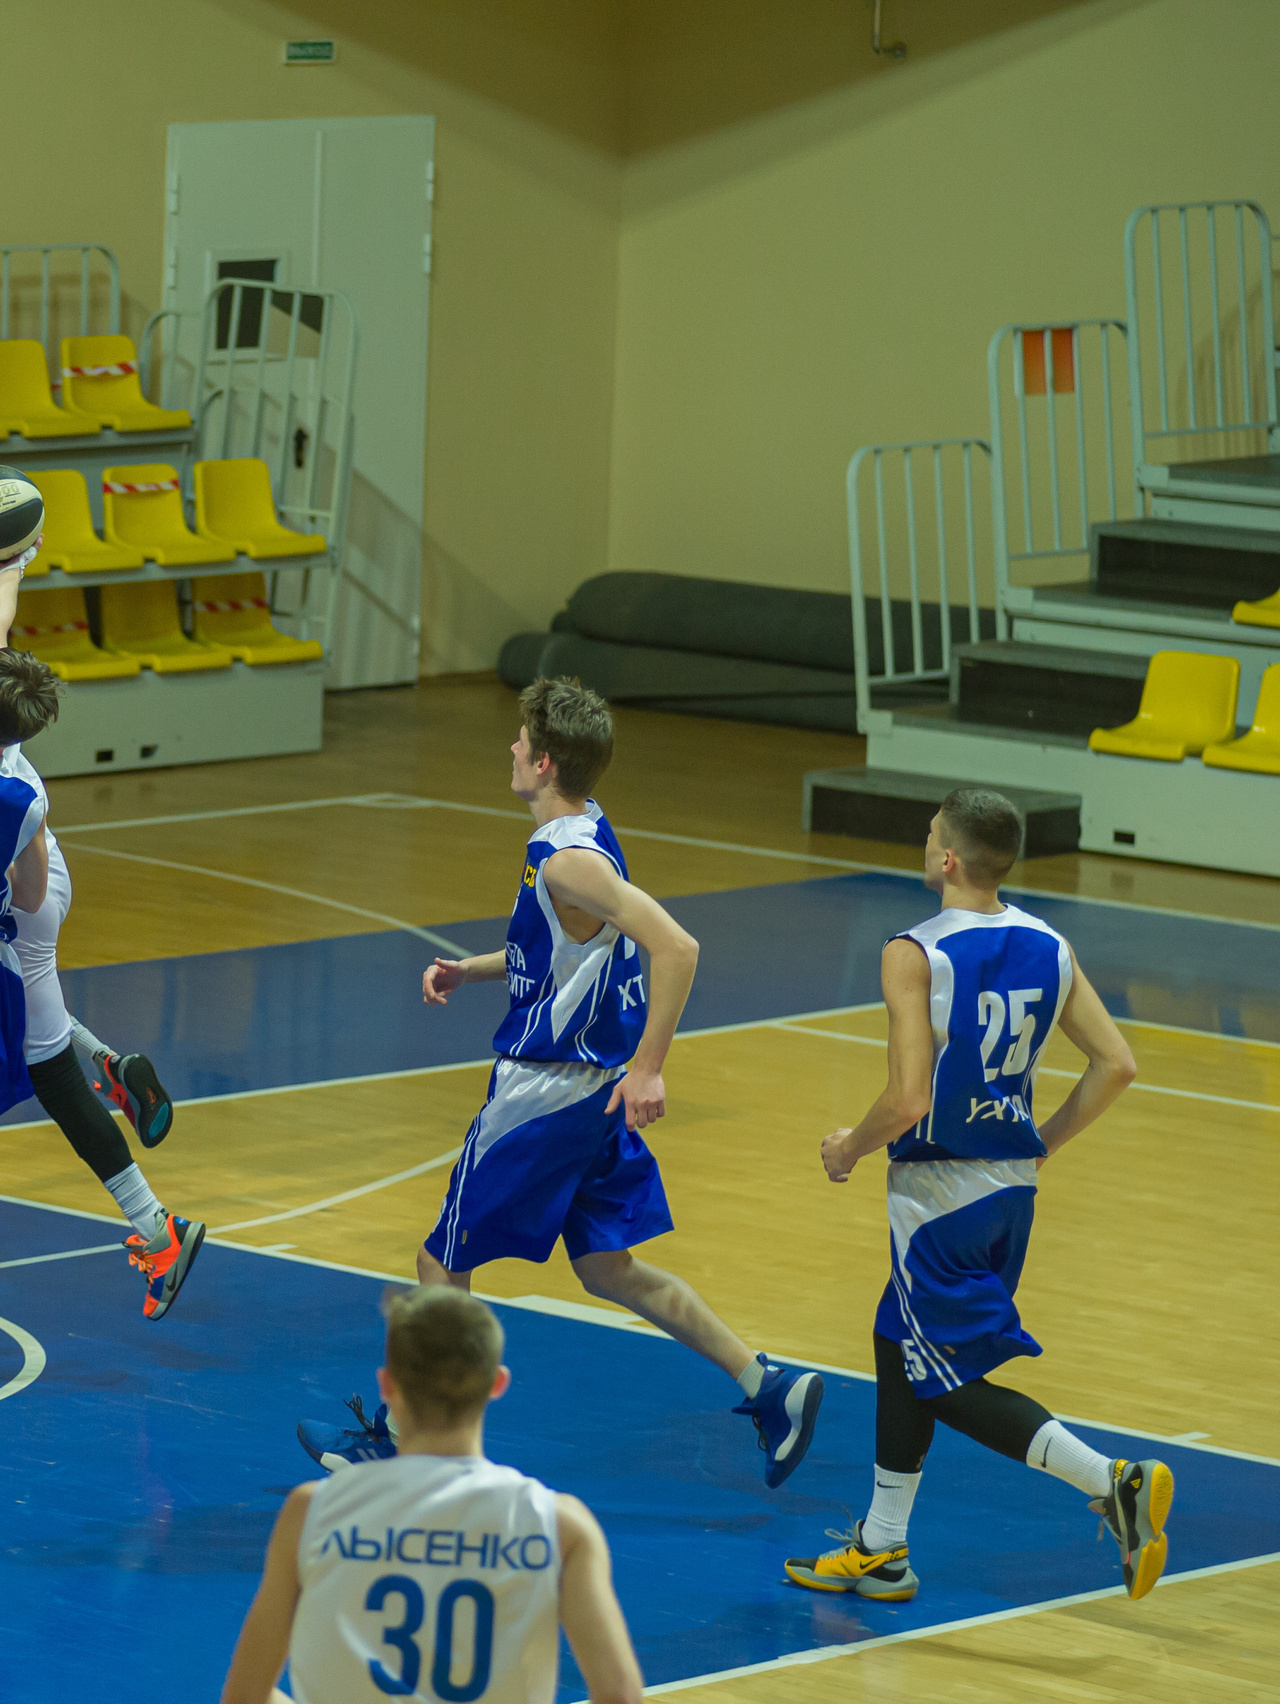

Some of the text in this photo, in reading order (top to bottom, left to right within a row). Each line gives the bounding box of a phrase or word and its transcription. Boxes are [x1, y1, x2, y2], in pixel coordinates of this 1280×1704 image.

[978, 988, 1043, 1083] 25
[901, 1339, 927, 1381] 5
[320, 1525, 552, 1571] ЛЫСЕНКО
[364, 1573, 495, 1703] 30
